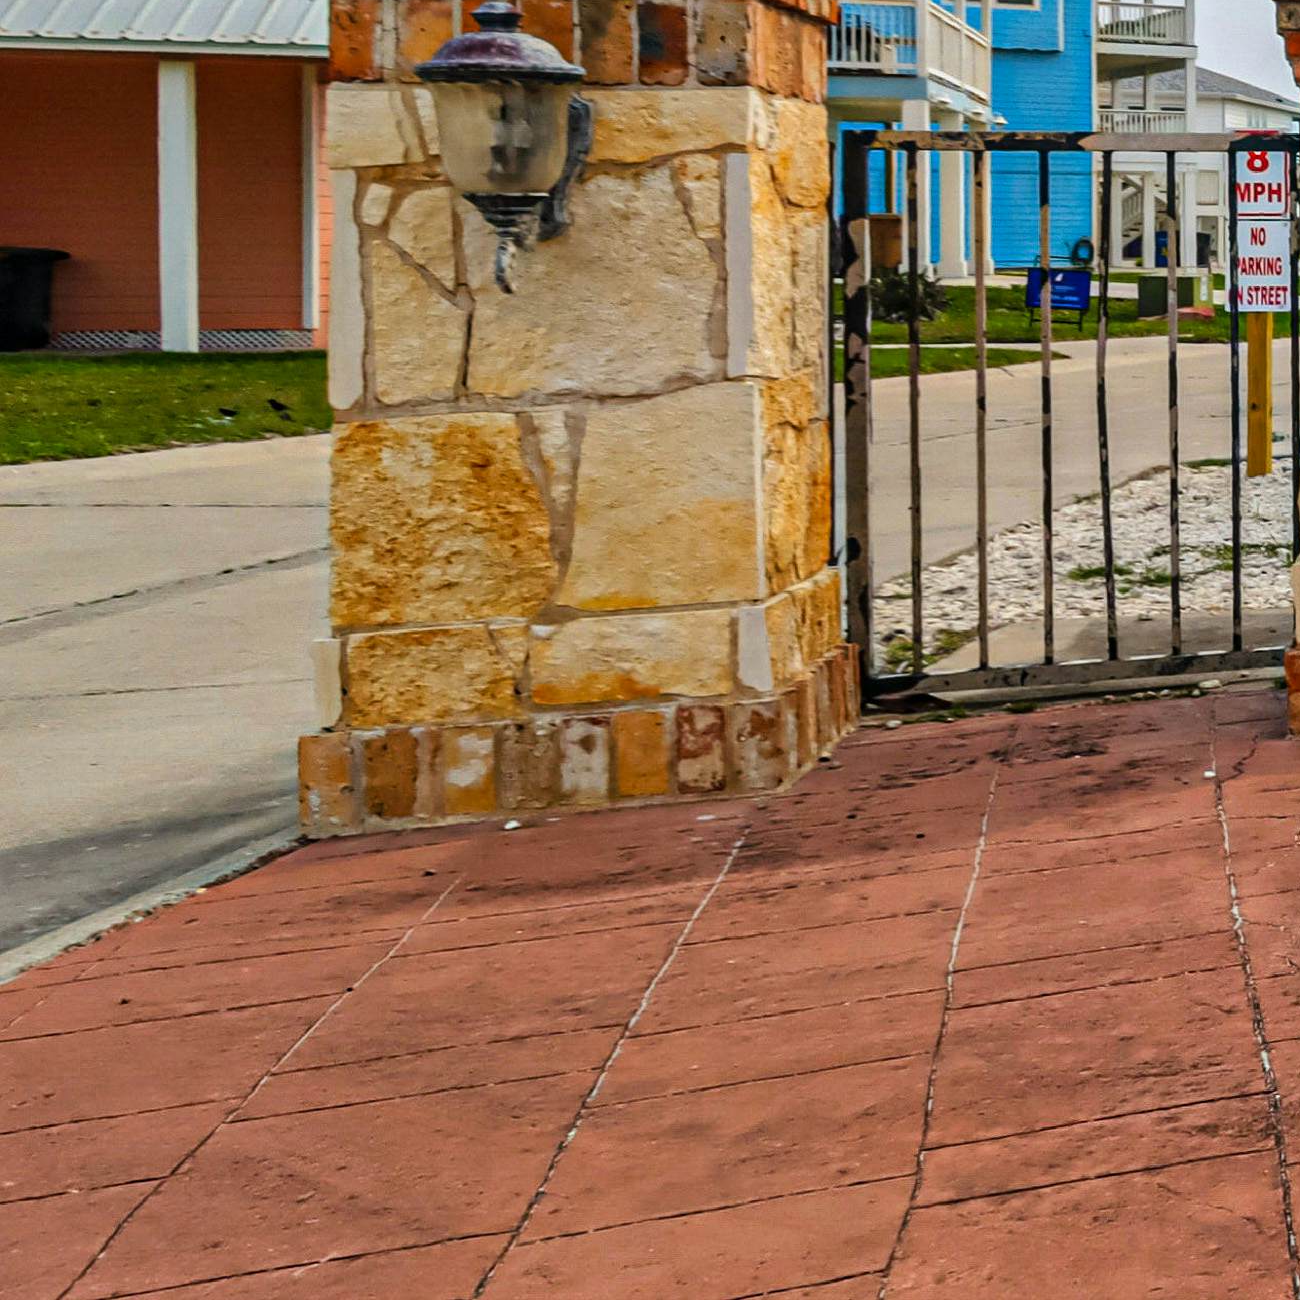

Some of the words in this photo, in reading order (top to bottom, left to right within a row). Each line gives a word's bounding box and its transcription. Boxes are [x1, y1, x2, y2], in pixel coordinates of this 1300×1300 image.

[1246, 150, 1269, 174] 8
[1235, 182, 1282, 203] MPH
[1250, 227, 1266, 246] NO
[1229, 286, 1244, 305] N
[1246, 285, 1289, 305] STREET
